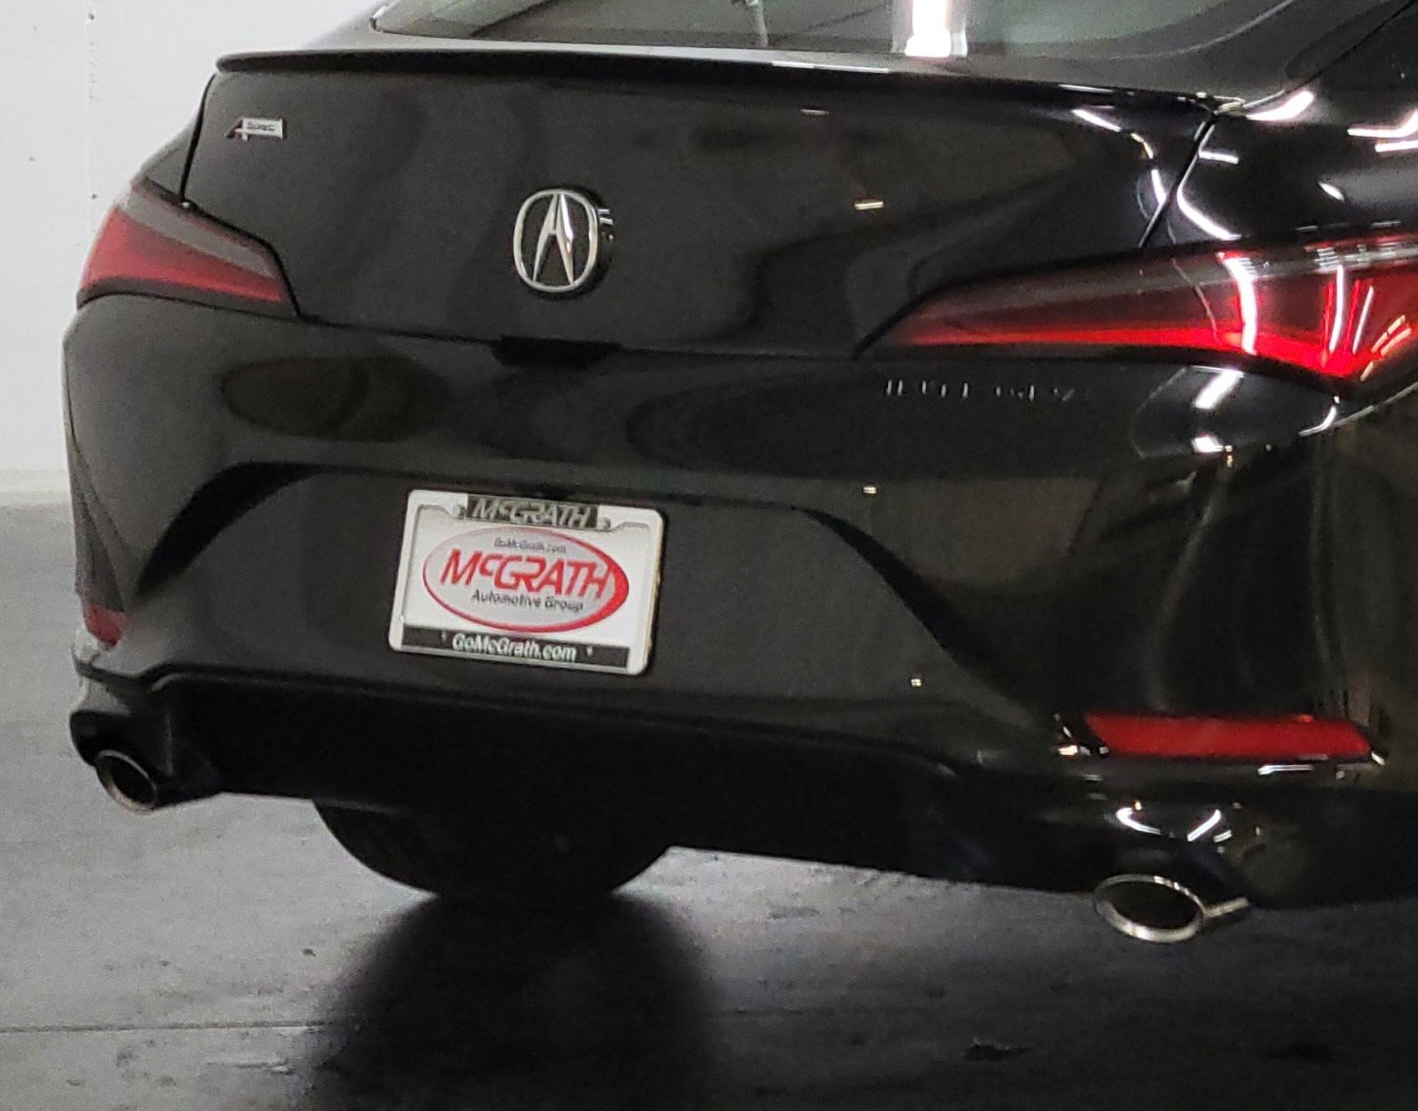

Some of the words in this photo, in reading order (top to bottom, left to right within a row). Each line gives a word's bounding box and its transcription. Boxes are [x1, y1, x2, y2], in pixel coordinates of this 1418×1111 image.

[472, 589, 542, 609] Automotive
[544, 595, 584, 613] Group
[452, 633, 576, 662] GoMcGrath.com
